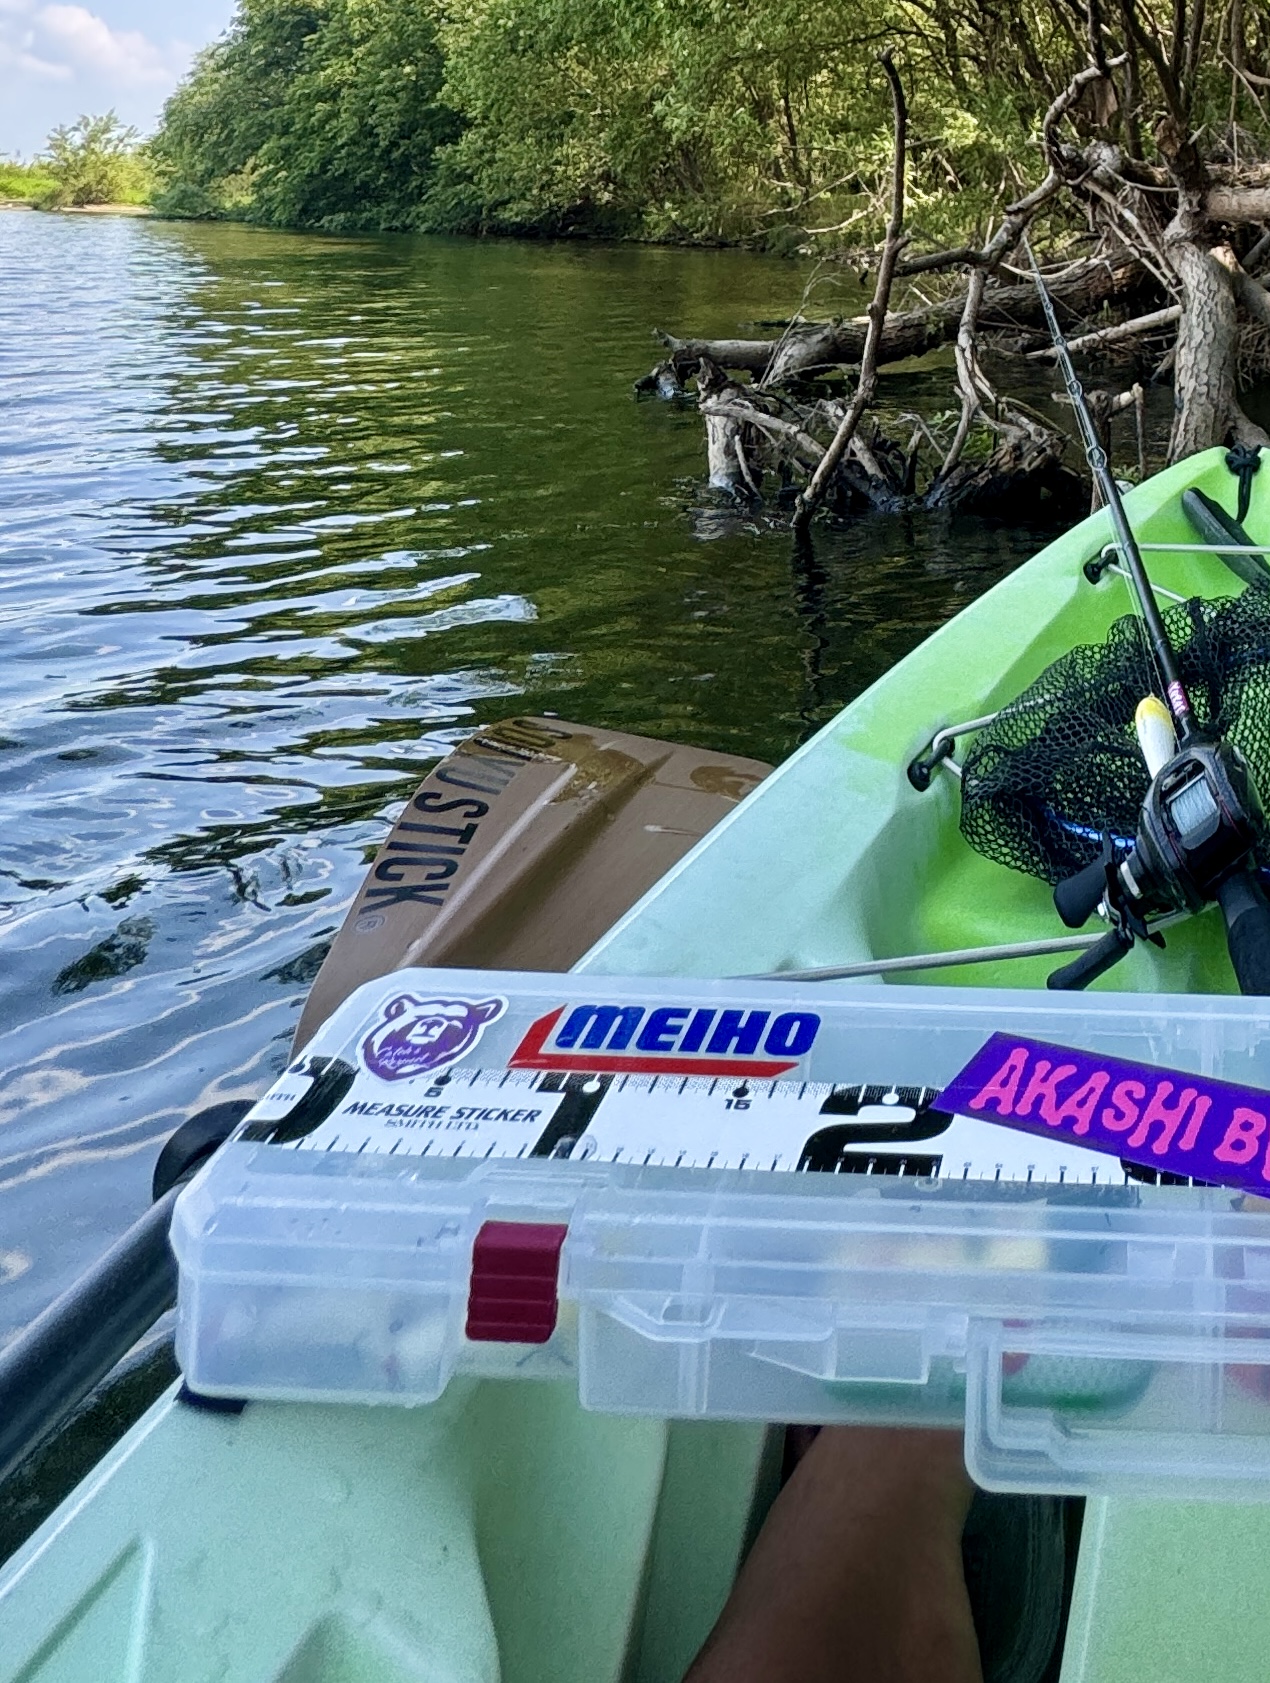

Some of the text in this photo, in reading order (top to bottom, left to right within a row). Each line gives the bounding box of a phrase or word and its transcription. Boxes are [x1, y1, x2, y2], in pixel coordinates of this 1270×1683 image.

[359, 791, 489, 915] STICK
[556, 1004, 821, 1057] MEIHO
[342, 1101, 542, 1124] MEASURE STICKER
[529, 1071, 614, 1159] 1
[799, 1085, 953, 1174] 2
[969, 1046, 1212, 1154] AKASHI
